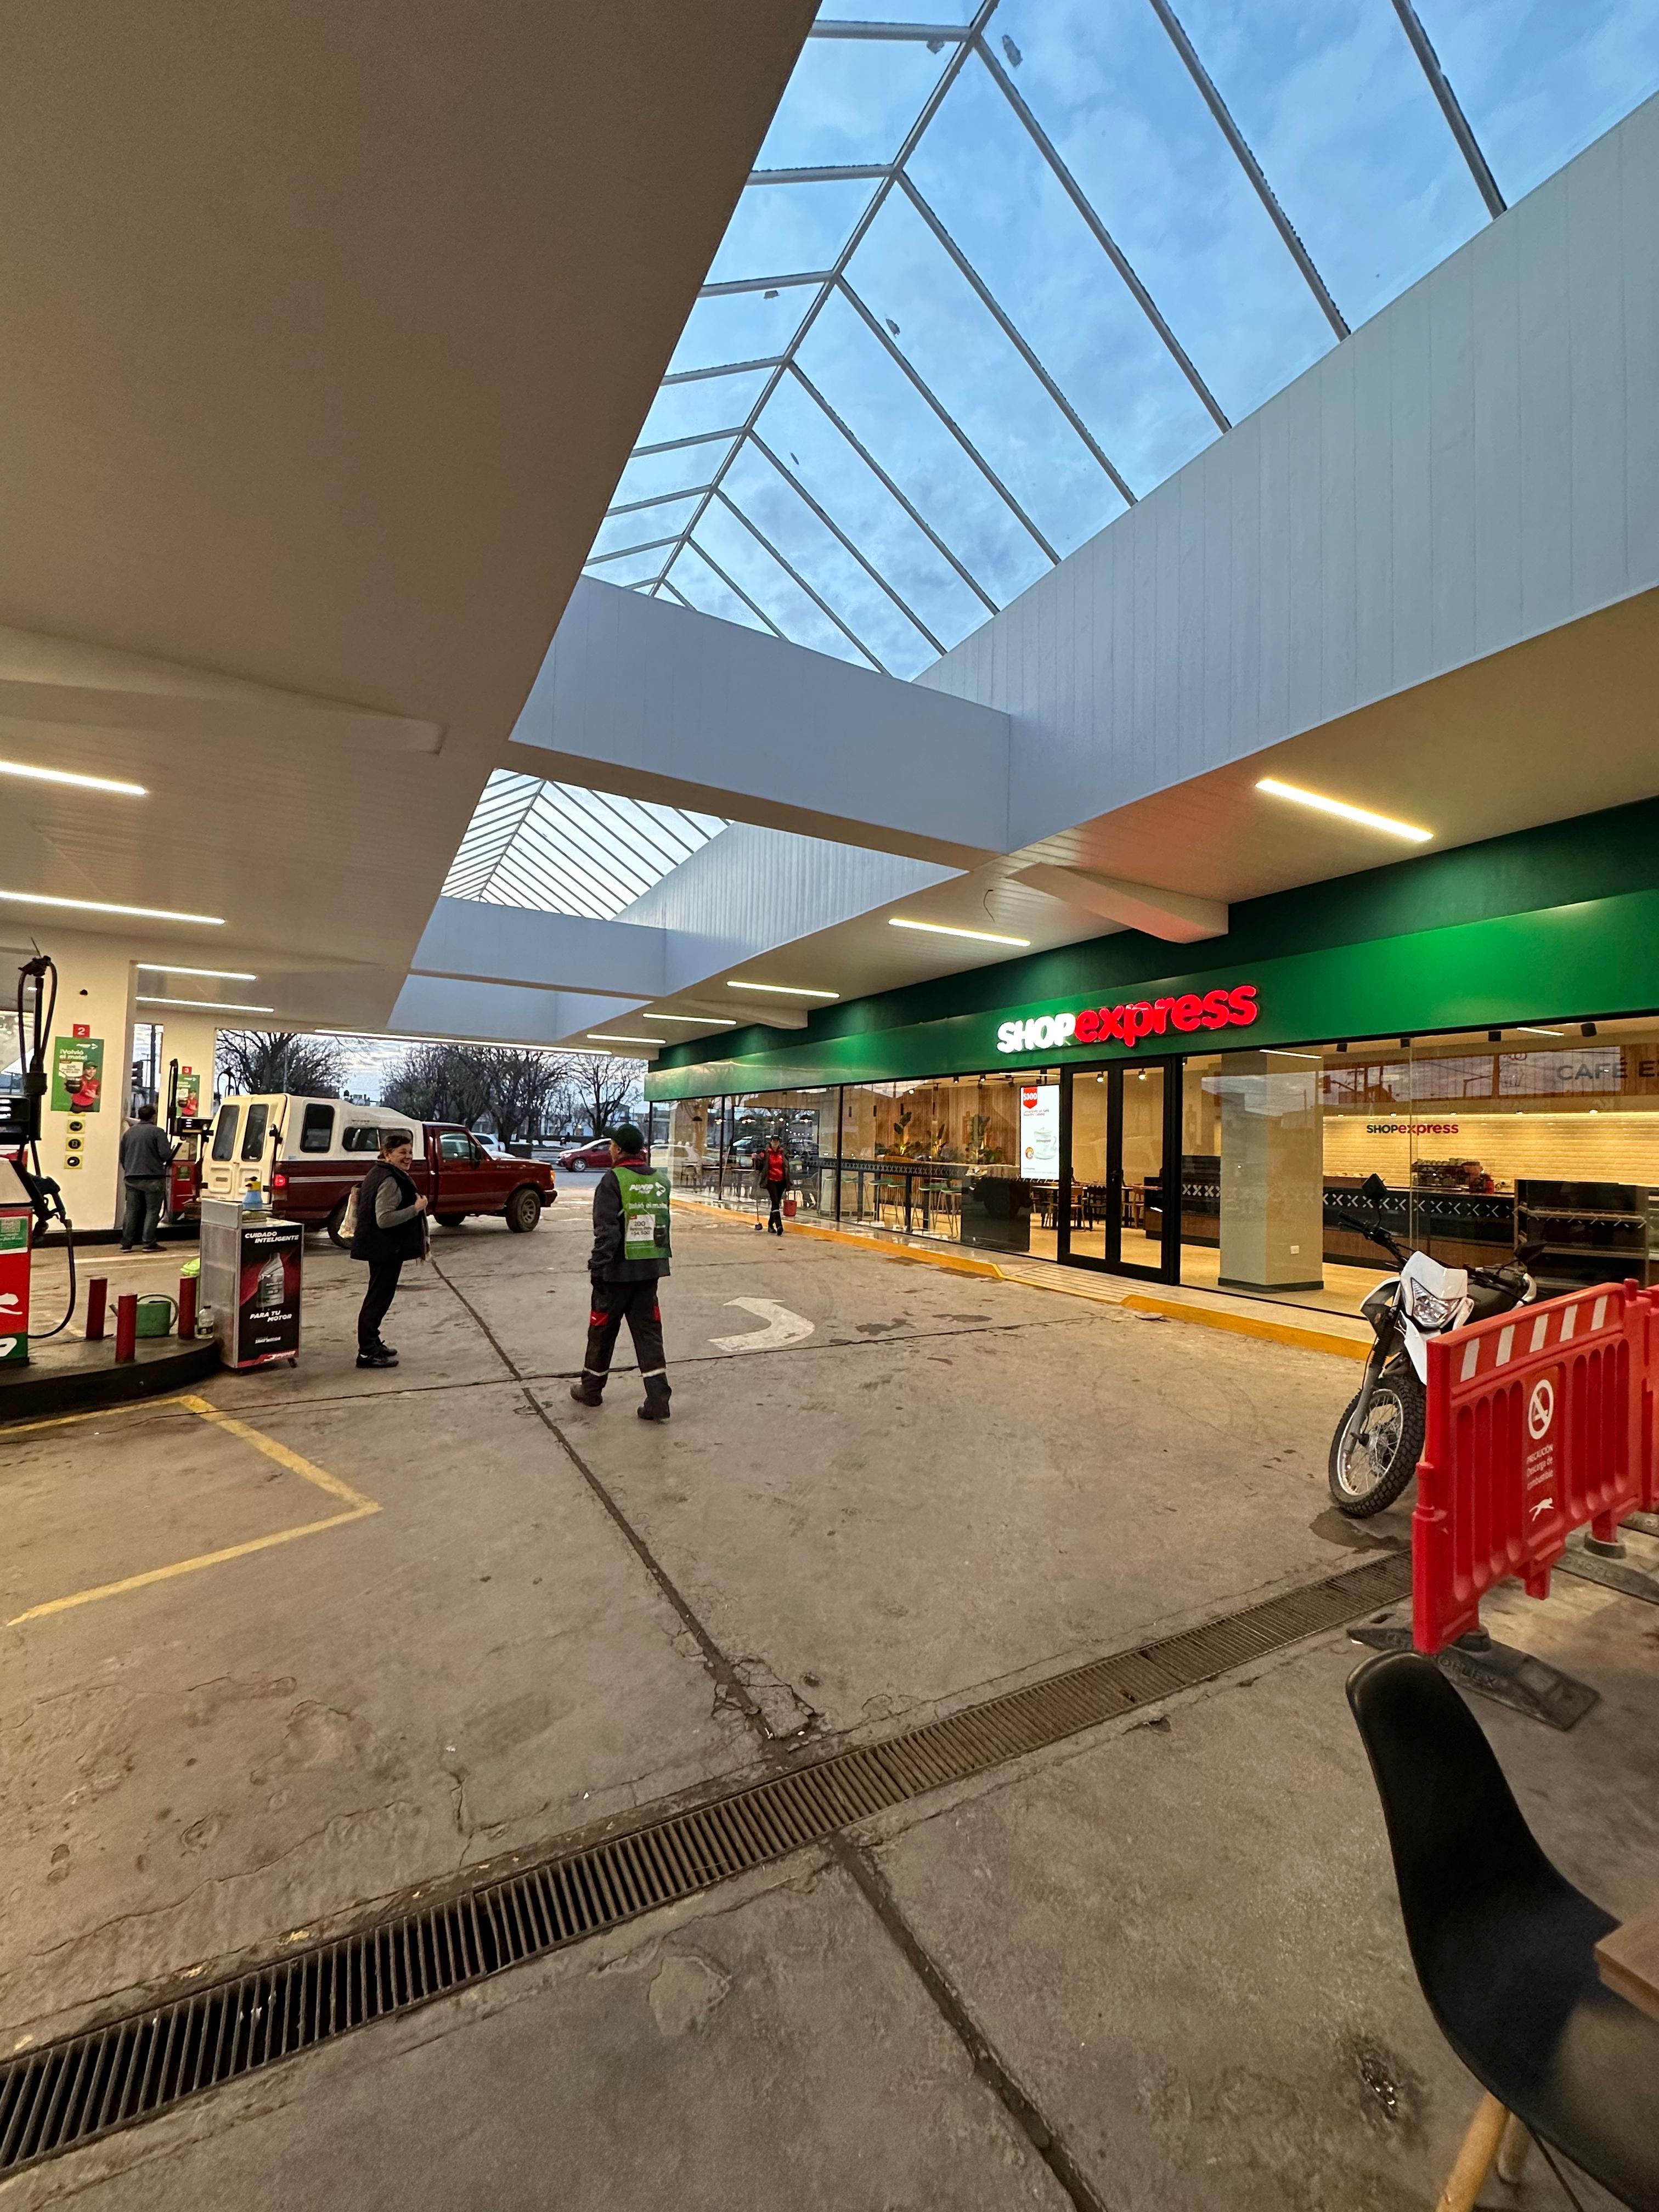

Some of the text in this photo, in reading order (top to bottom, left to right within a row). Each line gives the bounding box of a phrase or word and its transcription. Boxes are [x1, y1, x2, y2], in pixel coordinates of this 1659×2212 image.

[77, 1027, 86, 1035] 2
[1556, 1057, 1659, 1081] CAFÉ E
[1367, 1125, 1459, 1136] SHOPexpress
[255, 1234, 300, 1244] INTELIGENTE
[250, 1311, 269, 1319] PARA
[267, 1314, 292, 1323] MOTOR
[1527, 1444, 1554, 1465] PRECAUCIÓN
[1527, 1455, 1554, 1477] Descarga de
[1527, 1470, 1554, 1491] combustible
